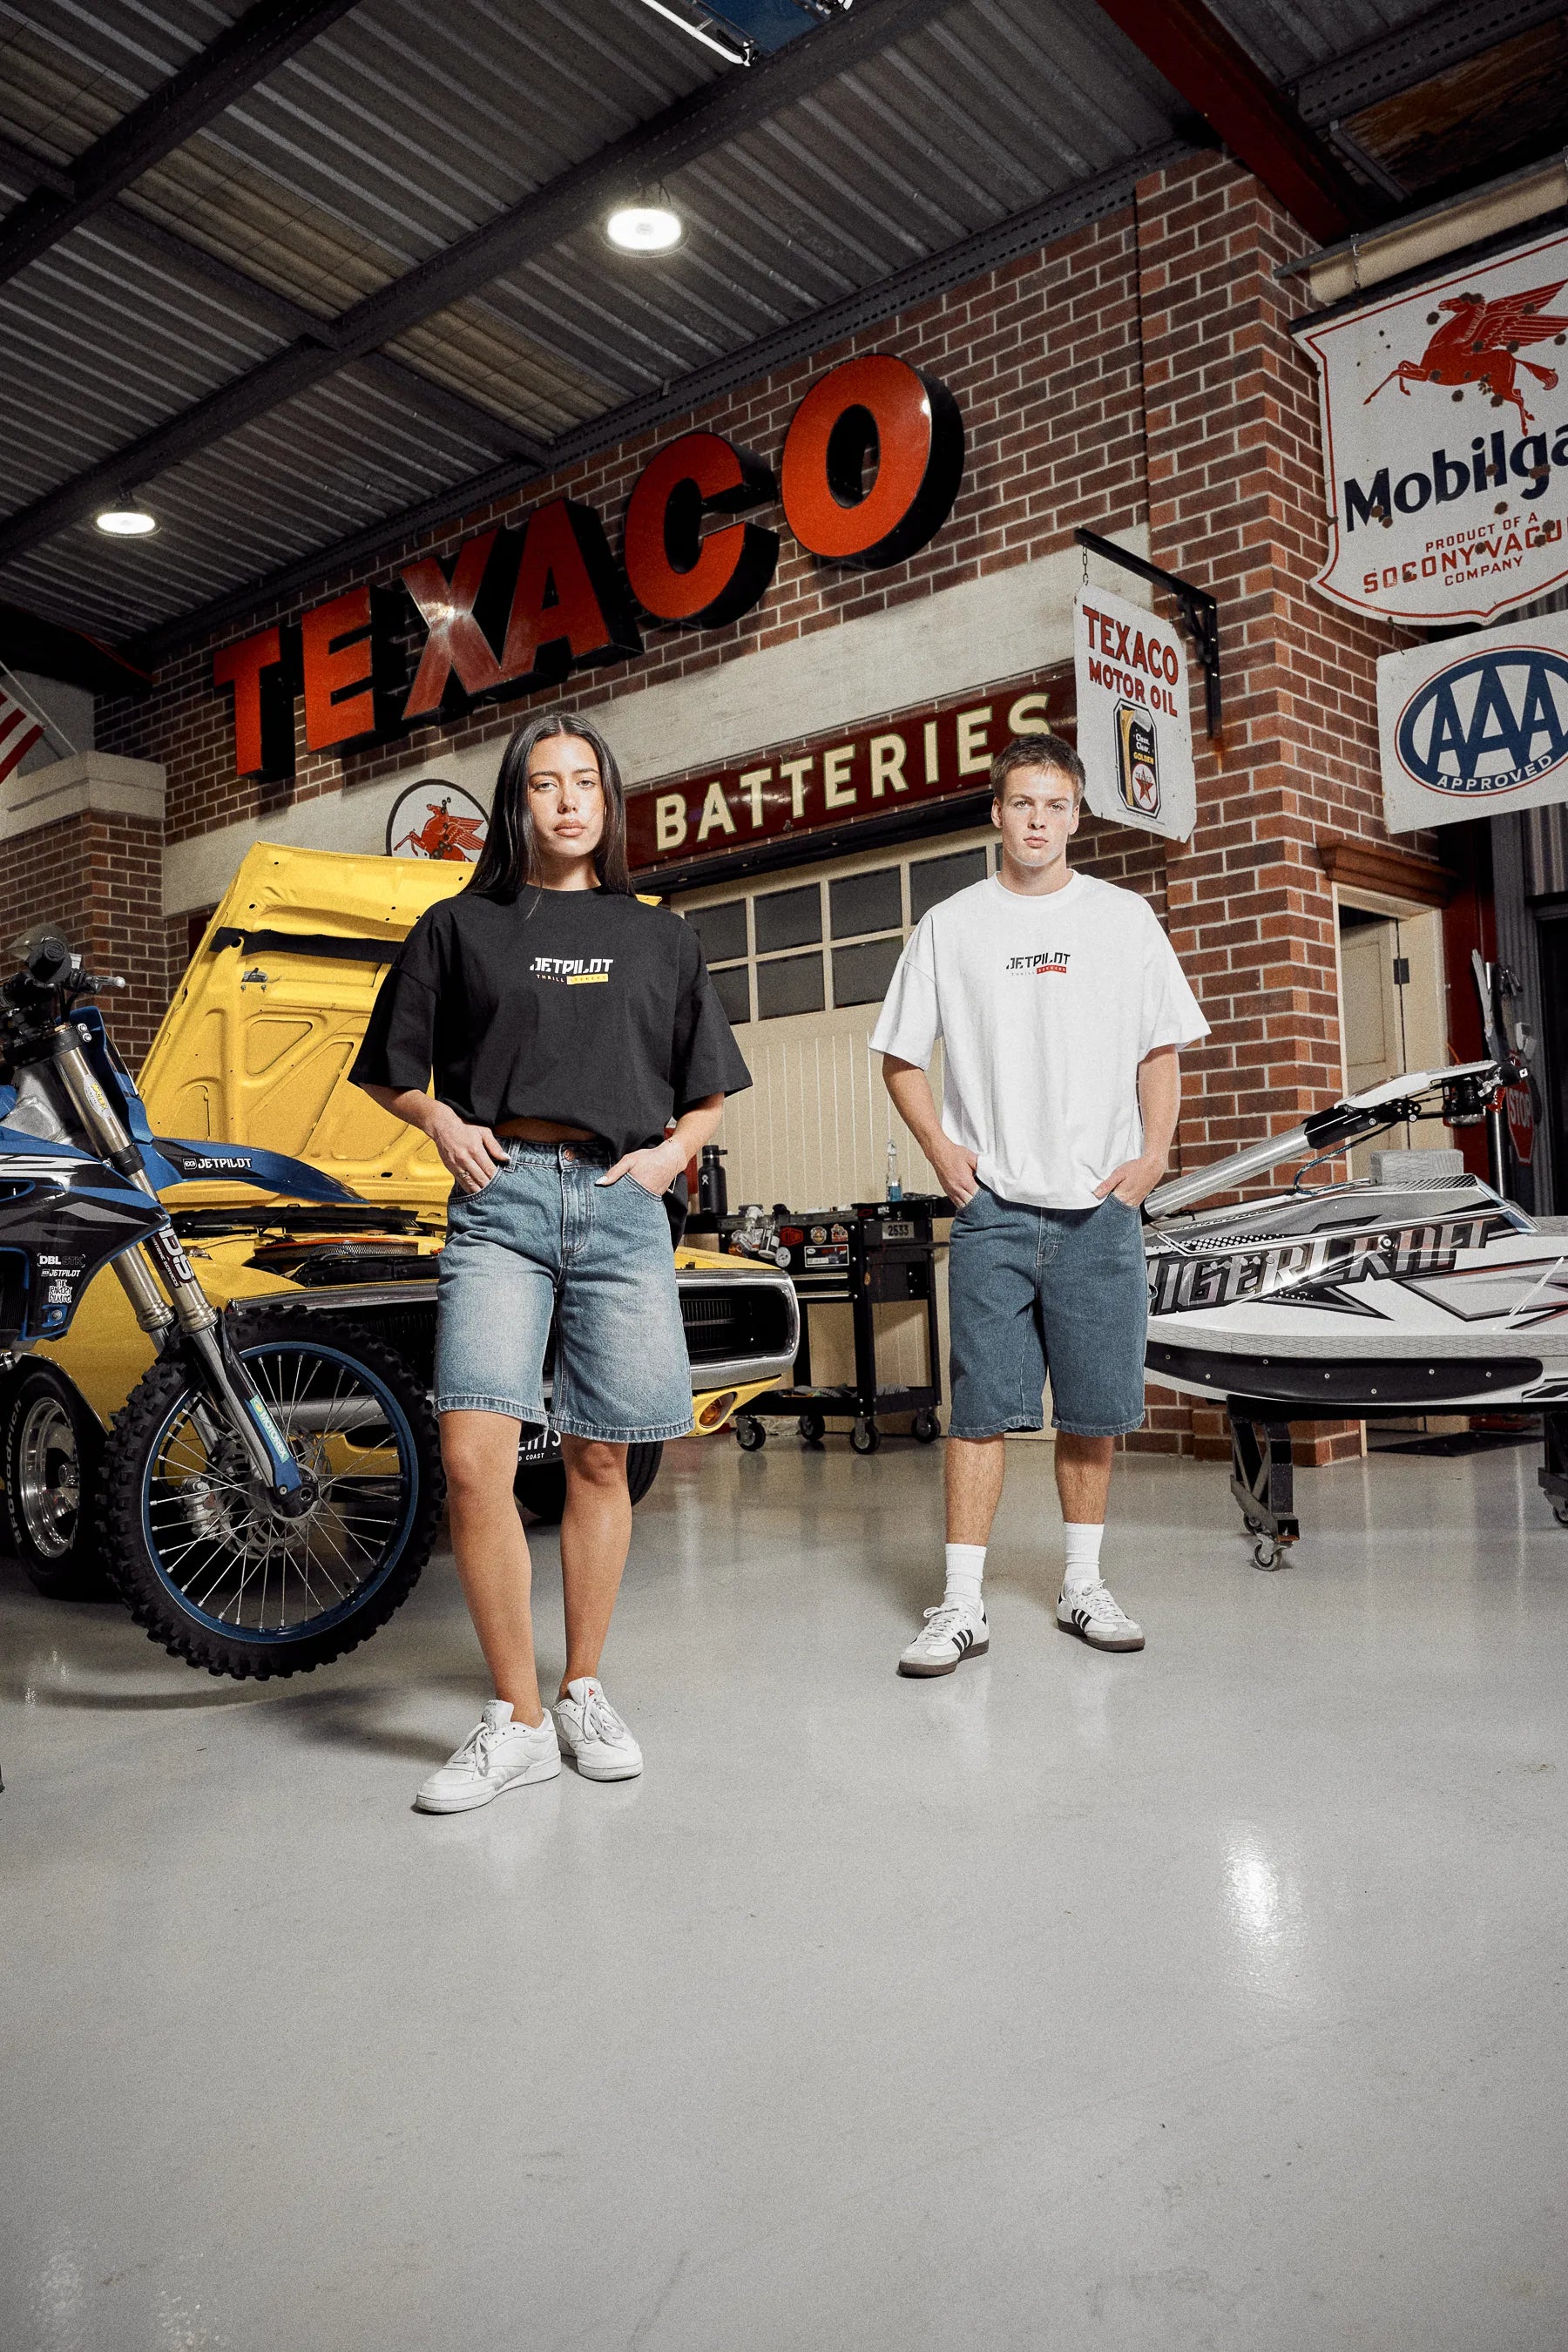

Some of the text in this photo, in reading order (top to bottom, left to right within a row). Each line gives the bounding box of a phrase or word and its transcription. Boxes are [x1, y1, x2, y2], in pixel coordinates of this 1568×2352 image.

[1425, 511, 1538, 552] PRODUCT OF A
[213, 353, 963, 781] TEXACO
[1444, 555, 1524, 586] COMPANY
[1082, 604, 1179, 686] TEXACO
[1088, 656, 1179, 718] MOTOR OIL
[1423, 659, 1566, 780] AAA
[655, 693, 1052, 852] BATTERIES
[1133, 751, 1154, 765] GOLDEN
[1436, 754, 1554, 791] APPROVED
[529, 957, 614, 975] JETPILOT
[1005, 952, 1071, 970] JETPILOT
[536, 974, 564, 983] THRILL
[198, 1158, 252, 1169] JETPILOT
[49, 1269, 81, 1278] JETPILOT
[260, 1411, 287, 1459] MOTOREX
[525, 1452, 545, 1461] COAST
